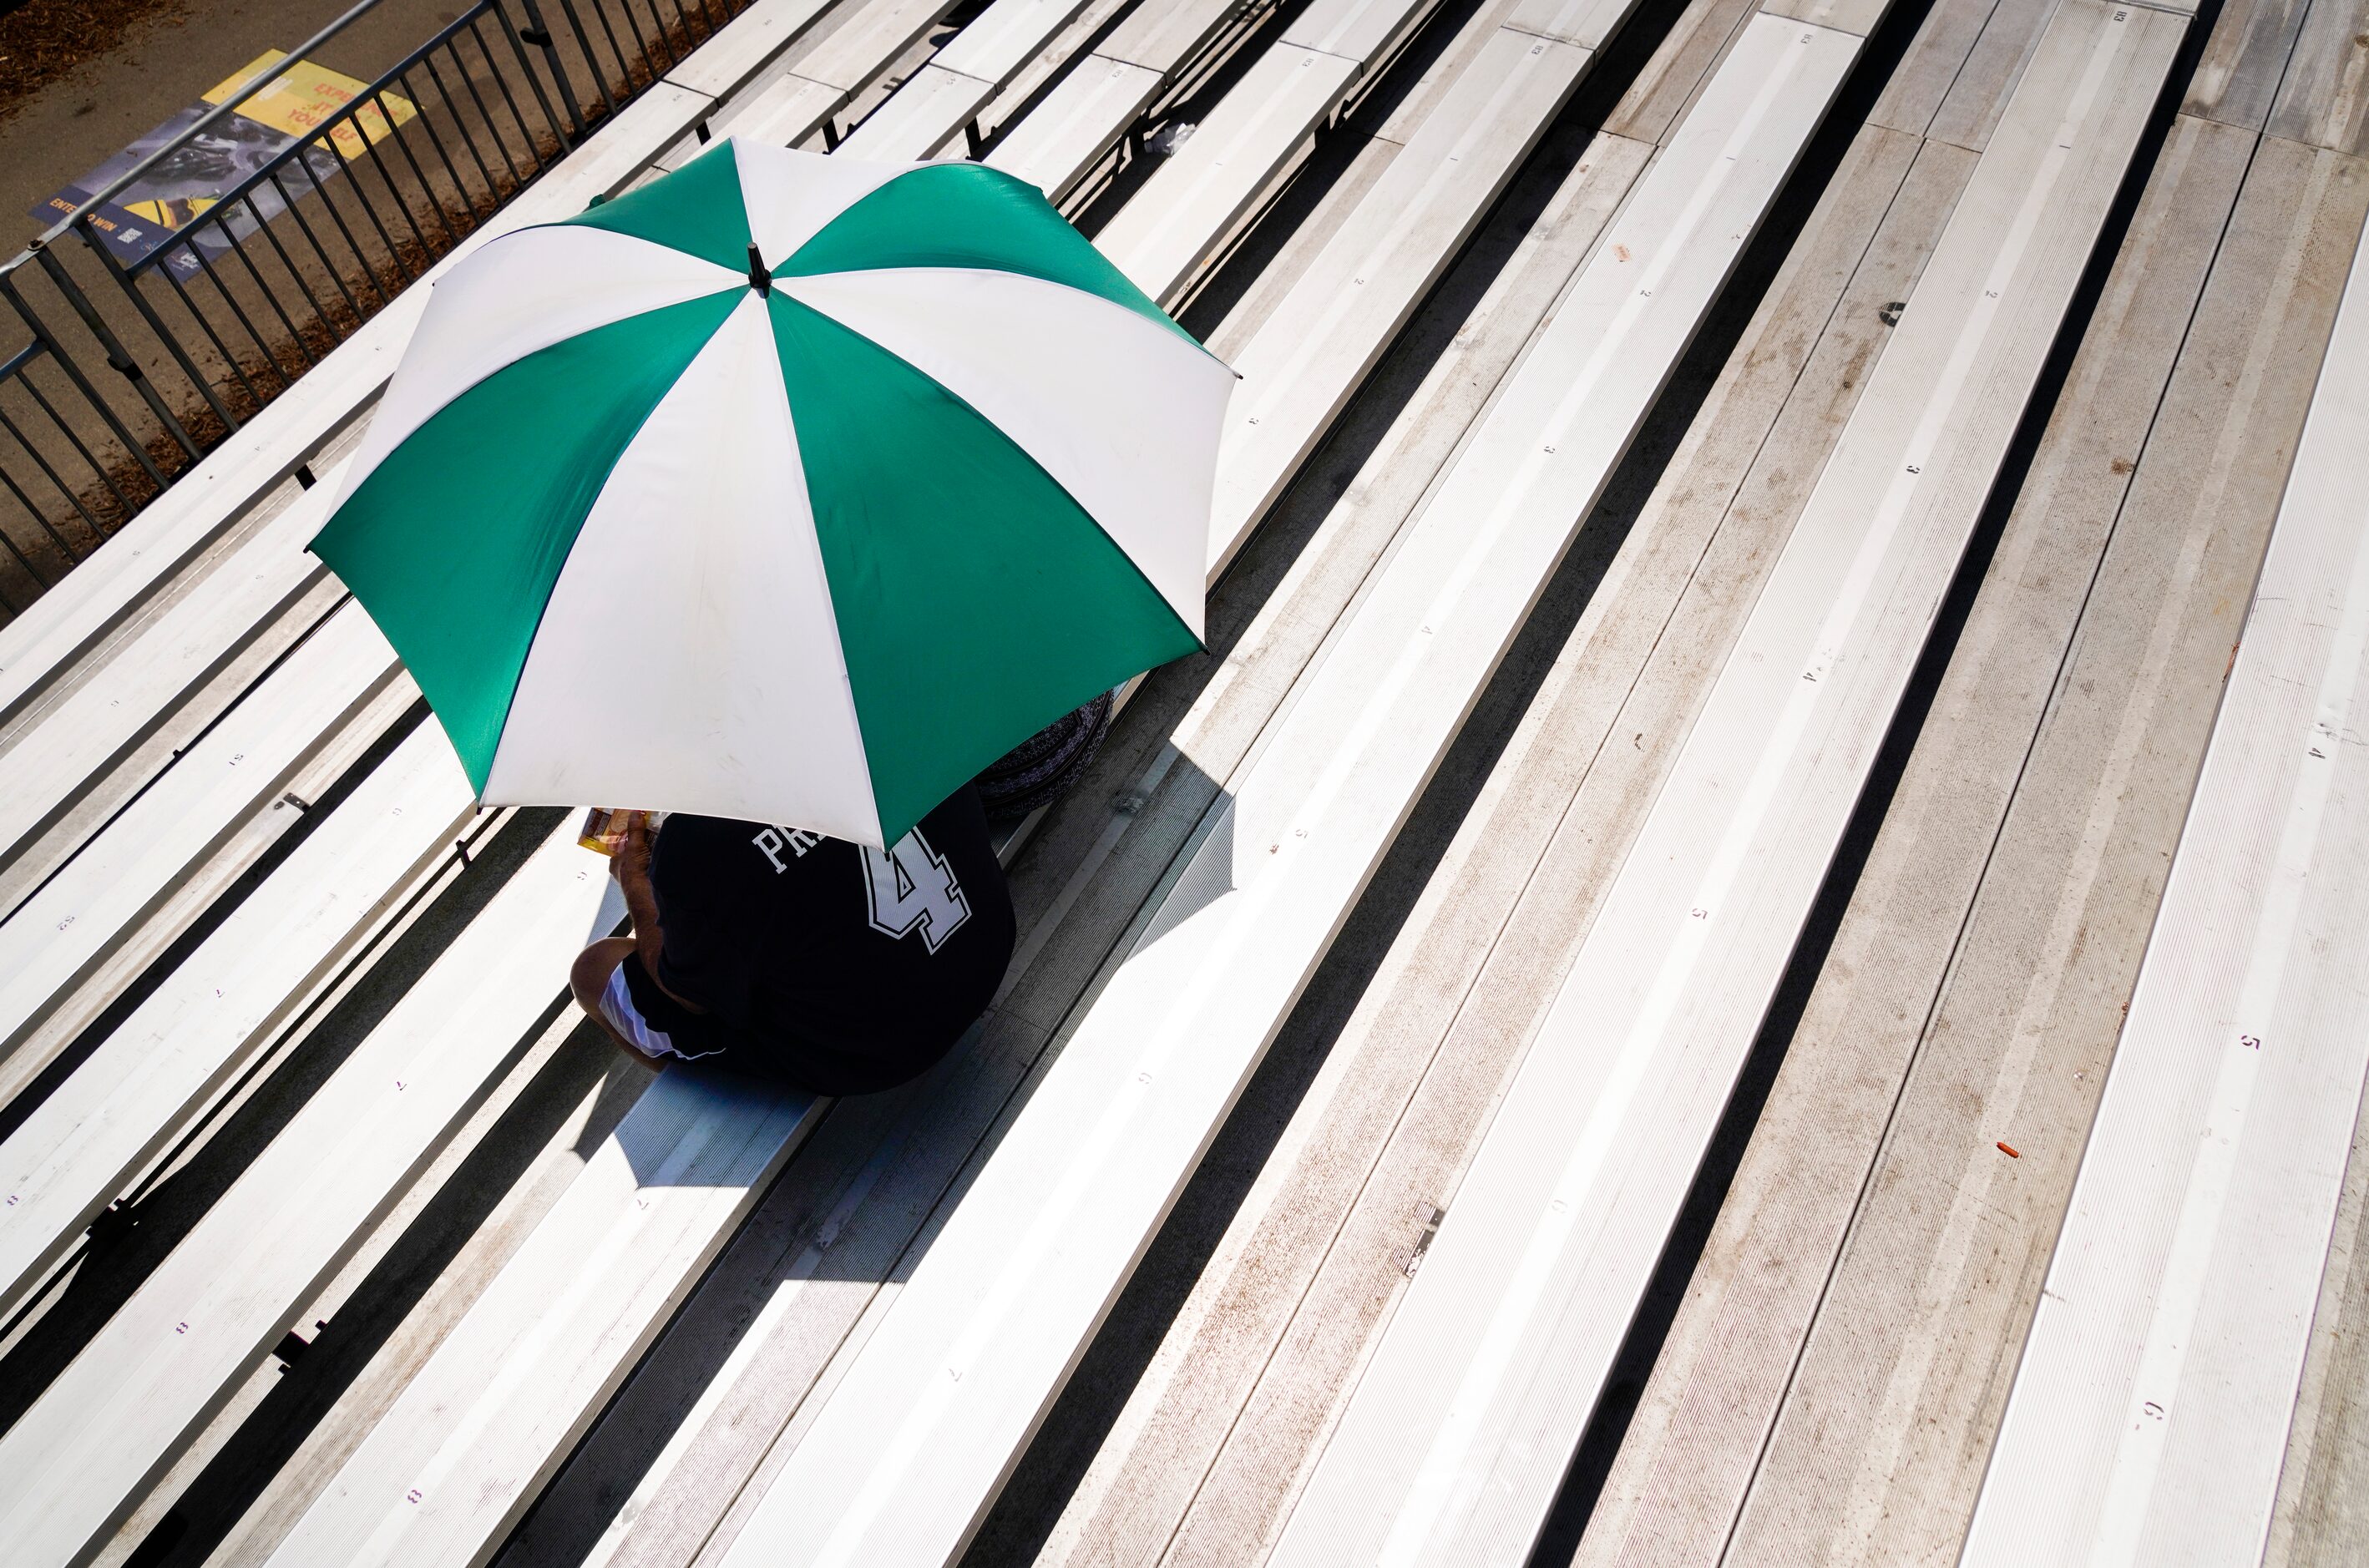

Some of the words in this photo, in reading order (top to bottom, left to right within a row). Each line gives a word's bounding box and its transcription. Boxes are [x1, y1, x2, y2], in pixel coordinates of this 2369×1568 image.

[50, 197, 78, 214] ENTE
[93, 217, 118, 232] WIN
[858, 825, 973, 956] 4
[2240, 1034, 2260, 1050] 5
[175, 1322, 190, 1335] 8
[407, 1489, 423, 1505] 8
